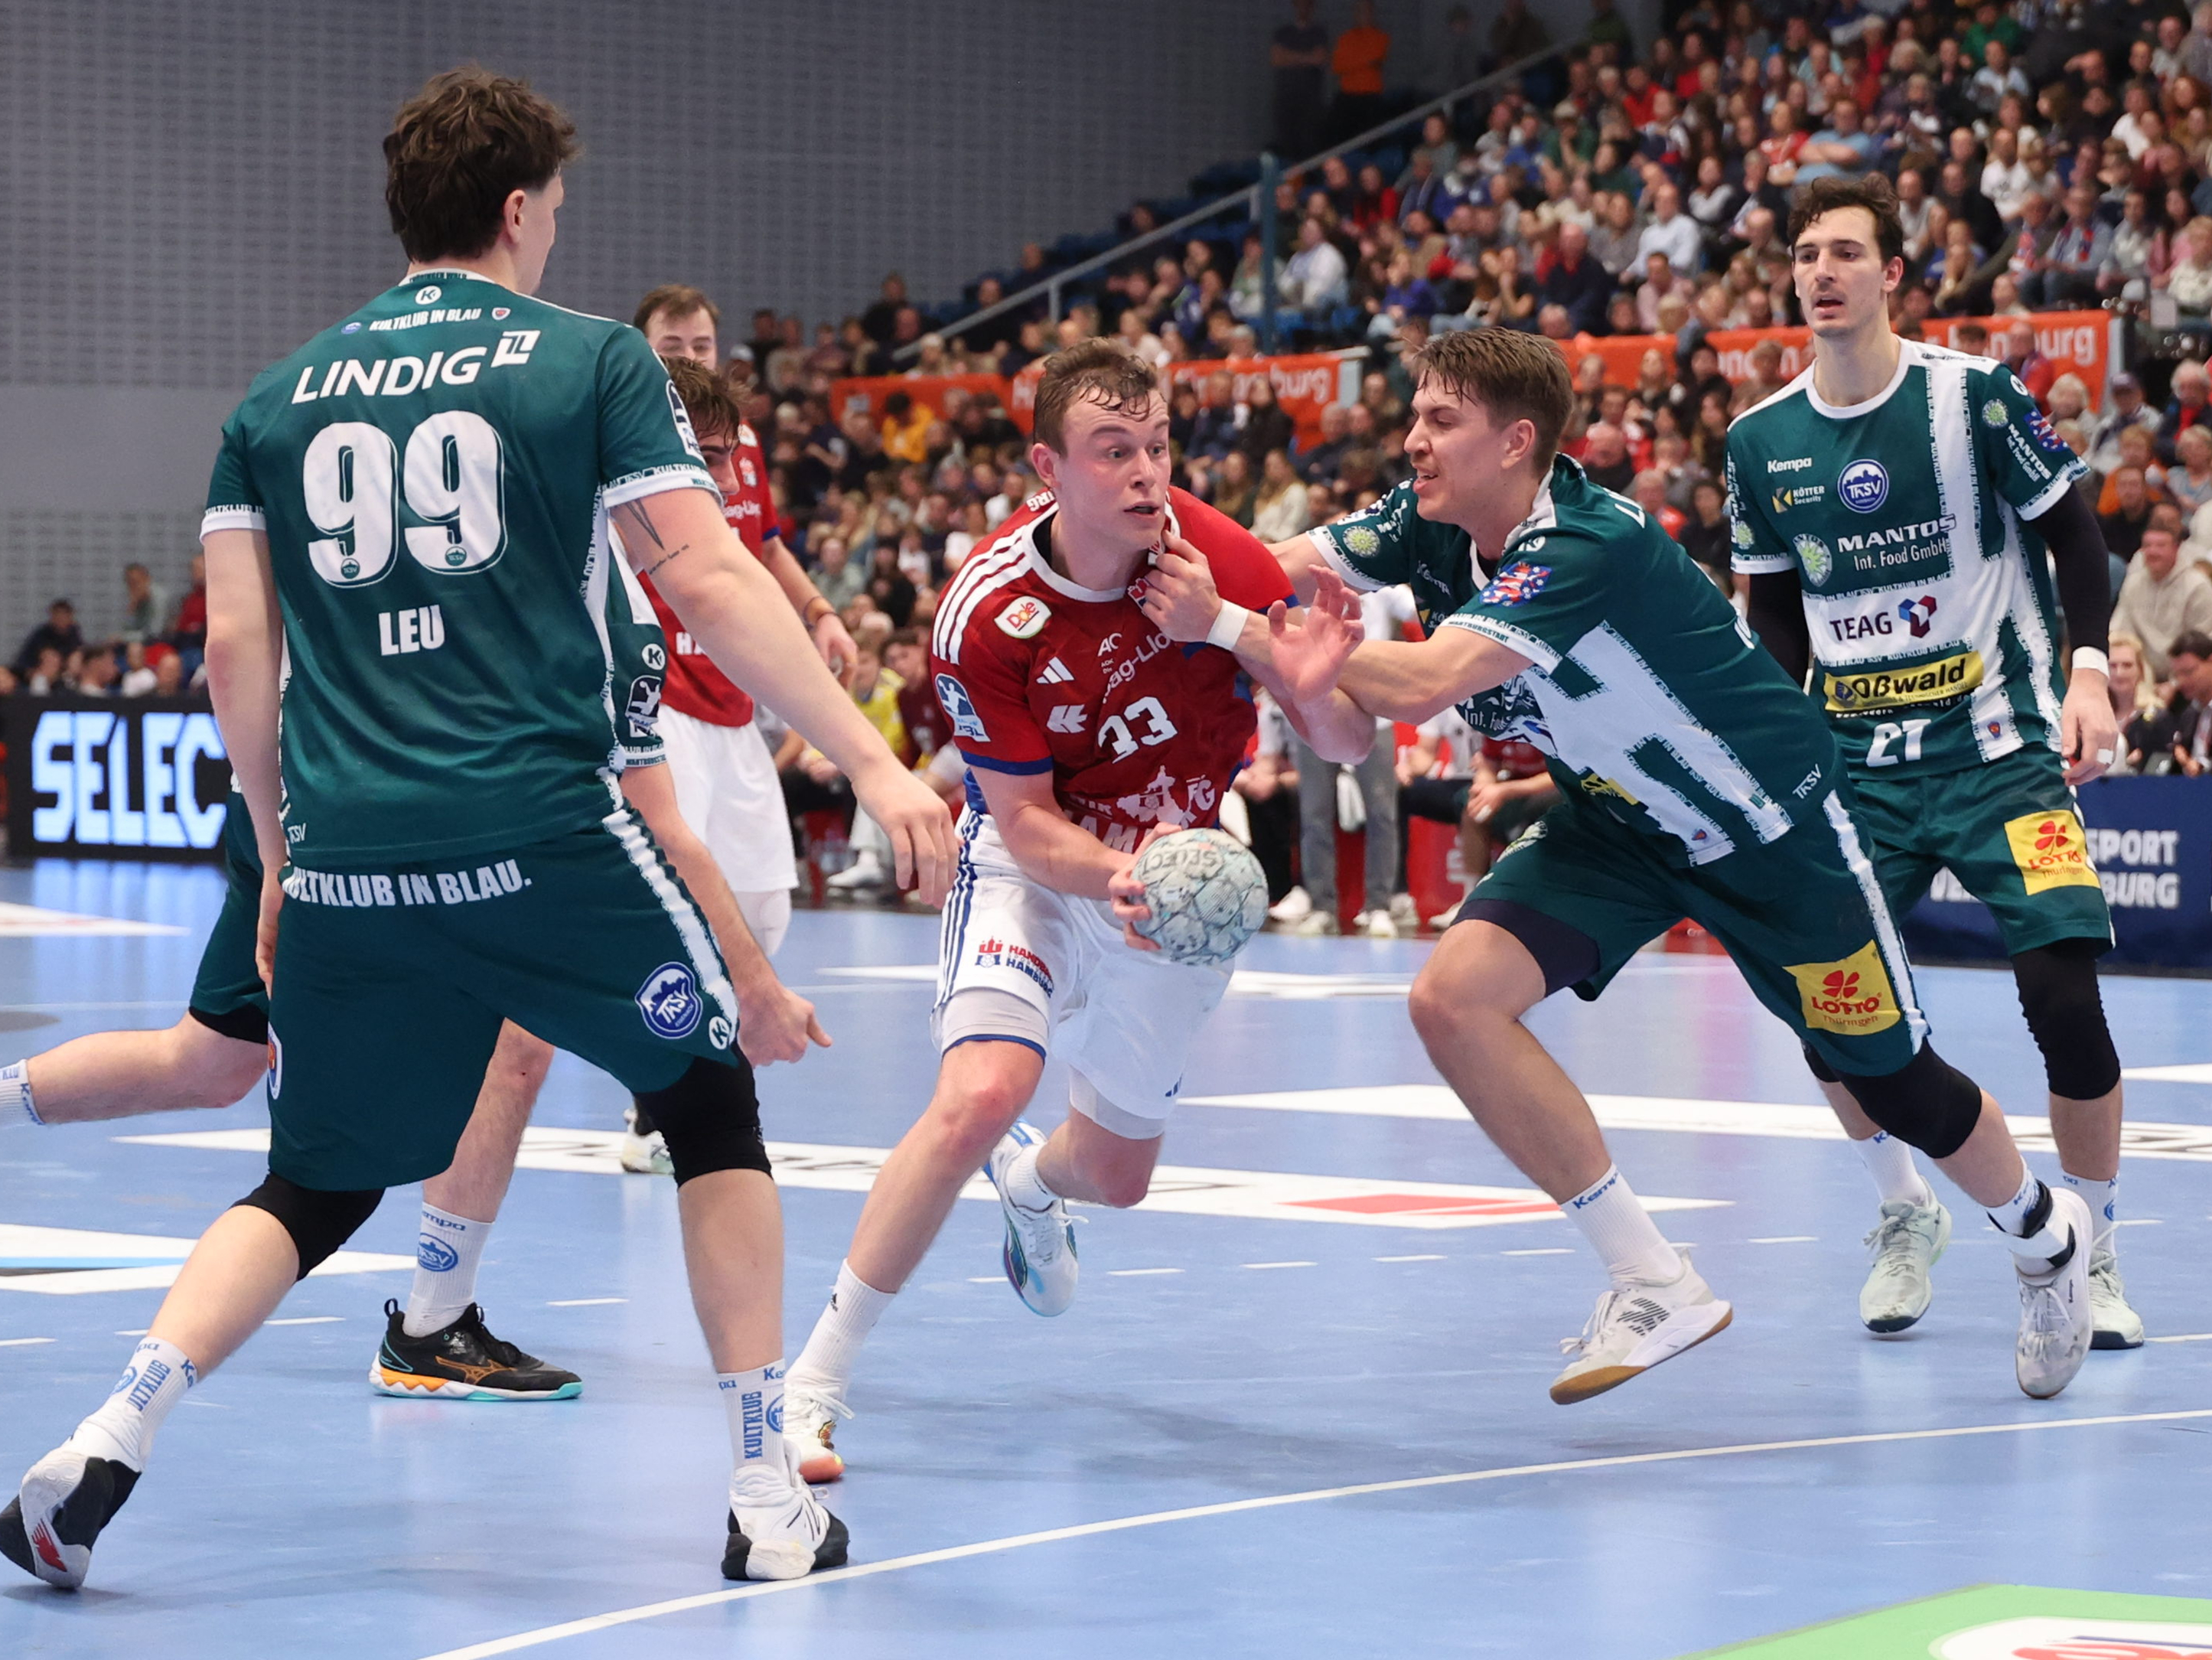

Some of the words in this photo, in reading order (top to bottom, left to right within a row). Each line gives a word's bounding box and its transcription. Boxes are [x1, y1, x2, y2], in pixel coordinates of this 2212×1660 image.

[369, 311, 428, 331] KULTKLUB
[430, 309, 441, 323] IN
[446, 308, 481, 321] BLAU
[292, 346, 487, 404] LINDIG
[1767, 457, 1813, 473] Kempa
[2008, 422, 2053, 481] MANTOS
[303, 410, 508, 588] 99
[1793, 485, 1825, 498] KÖTTER
[1793, 495, 1822, 505] Security
[1837, 513, 1957, 553] MANTOS
[1853, 554, 1877, 571] Int.
[1879, 546, 1908, 567] Food
[1911, 537, 1946, 562] GmbH
[378, 604, 445, 656] LEU
[1829, 611, 1893, 641] TEAG
[31, 710, 228, 849] SELEC
[398, 873, 436, 906] IN
[436, 859, 532, 905] BLAU.
[1810, 996, 1879, 1015] LOTTO
[741, 1391, 763, 1459] KULTKLUB
